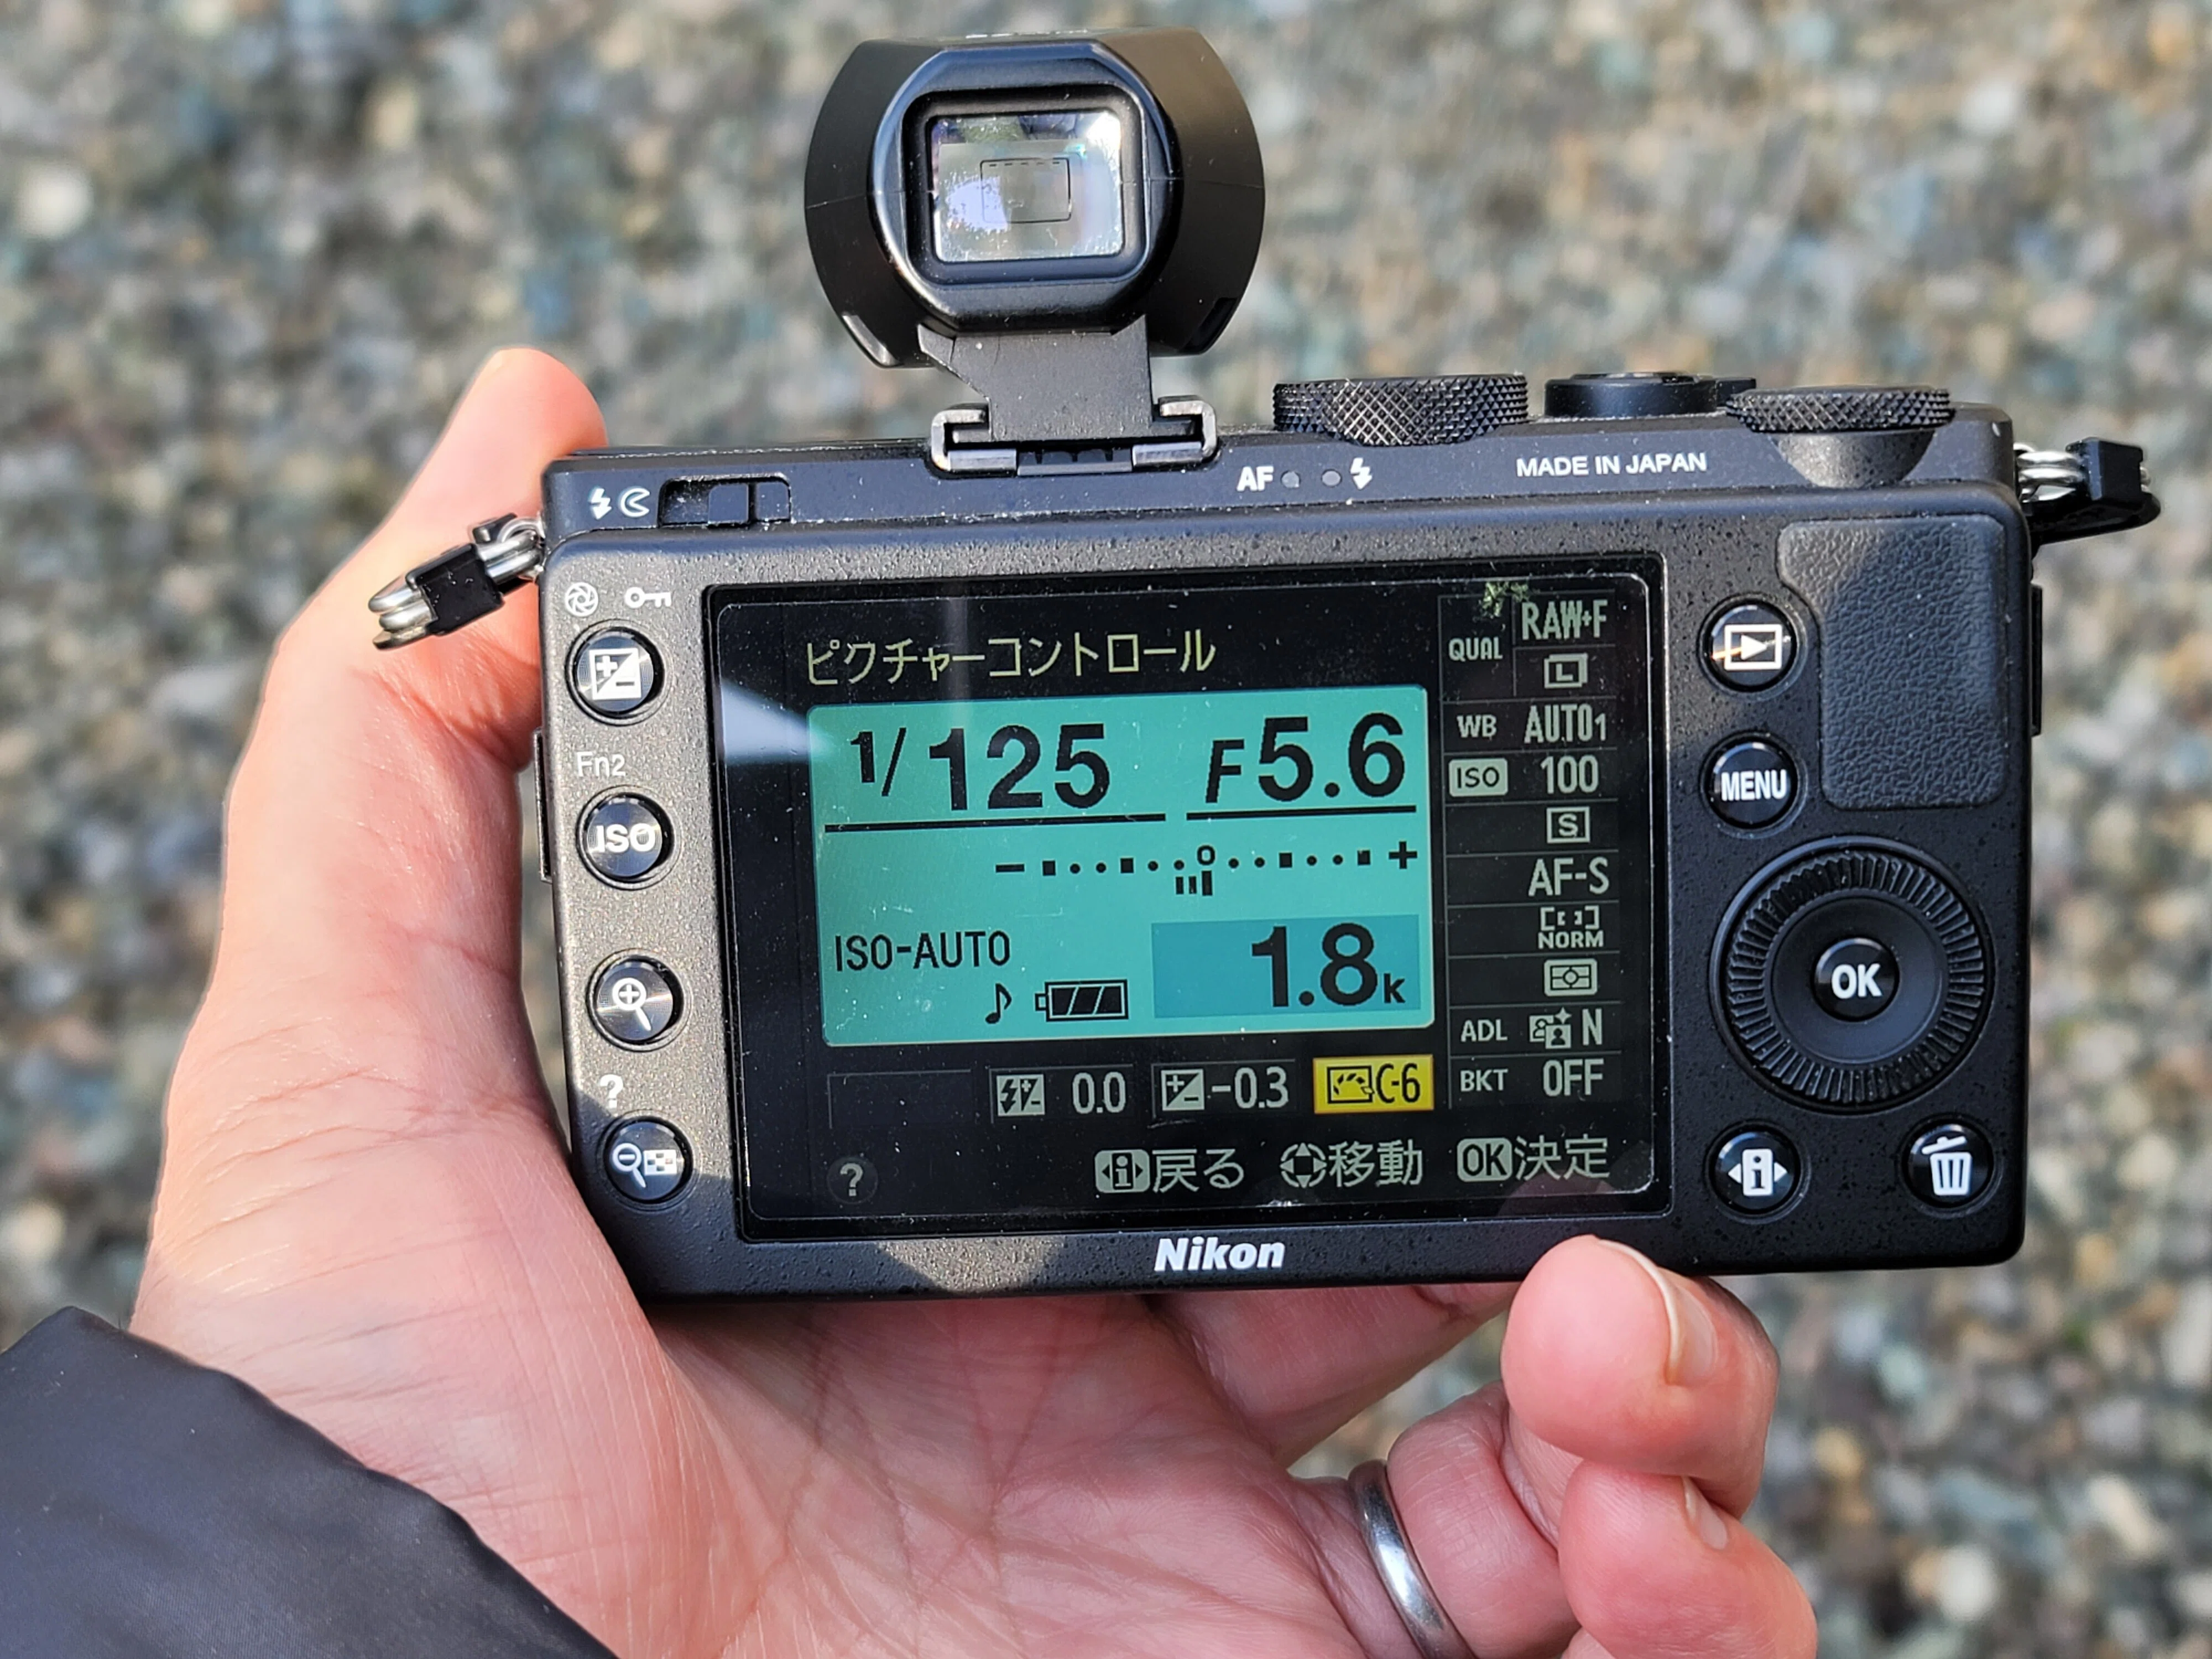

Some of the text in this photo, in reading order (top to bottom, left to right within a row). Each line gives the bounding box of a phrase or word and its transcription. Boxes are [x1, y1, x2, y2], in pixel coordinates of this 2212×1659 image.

[1236, 466, 1274, 491] AF
[1516, 452, 1707, 477] MADE IN JAPAN
[1521, 599, 1608, 641] RAW+F
[807, 629, 1216, 685] ピクチャーコントロール
[1448, 637, 1503, 661] QUAL
[1556, 663, 1573, 681] L
[1457, 703, 1607, 743] WB AUTO1
[576, 751, 626, 777] Fn2
[850, 723, 1110, 811] 1/125
[1205, 712, 1405, 804] F5.6
[1457, 754, 1599, 795] ISO 100
[1721, 769, 1787, 801] MENU
[588, 823, 656, 853] ISO
[1558, 813, 1579, 838] S
[1528, 856, 1610, 896] AF-S
[835, 930, 1011, 972] ISO-AUTO
[1537, 930, 1604, 950] NORM
[1251, 922, 1406, 1008] 1.8k
[1832, 963, 1882, 999] OK
[1460, 1008, 1603, 1046] ADL N
[1071, 1071, 1126, 1115] 0.0
[1212, 1066, 1289, 1109] -0.3
[1375, 1062, 1421, 1104] C-6
[1460, 1058, 1604, 1097] BKT OFF
[1152, 1148, 1245, 1193] 戻る
[1328, 1139, 1423, 1188] 移動
[1462, 1133, 1610, 1181] OK 決定
[1154, 1236, 1285, 1271] Nikon
